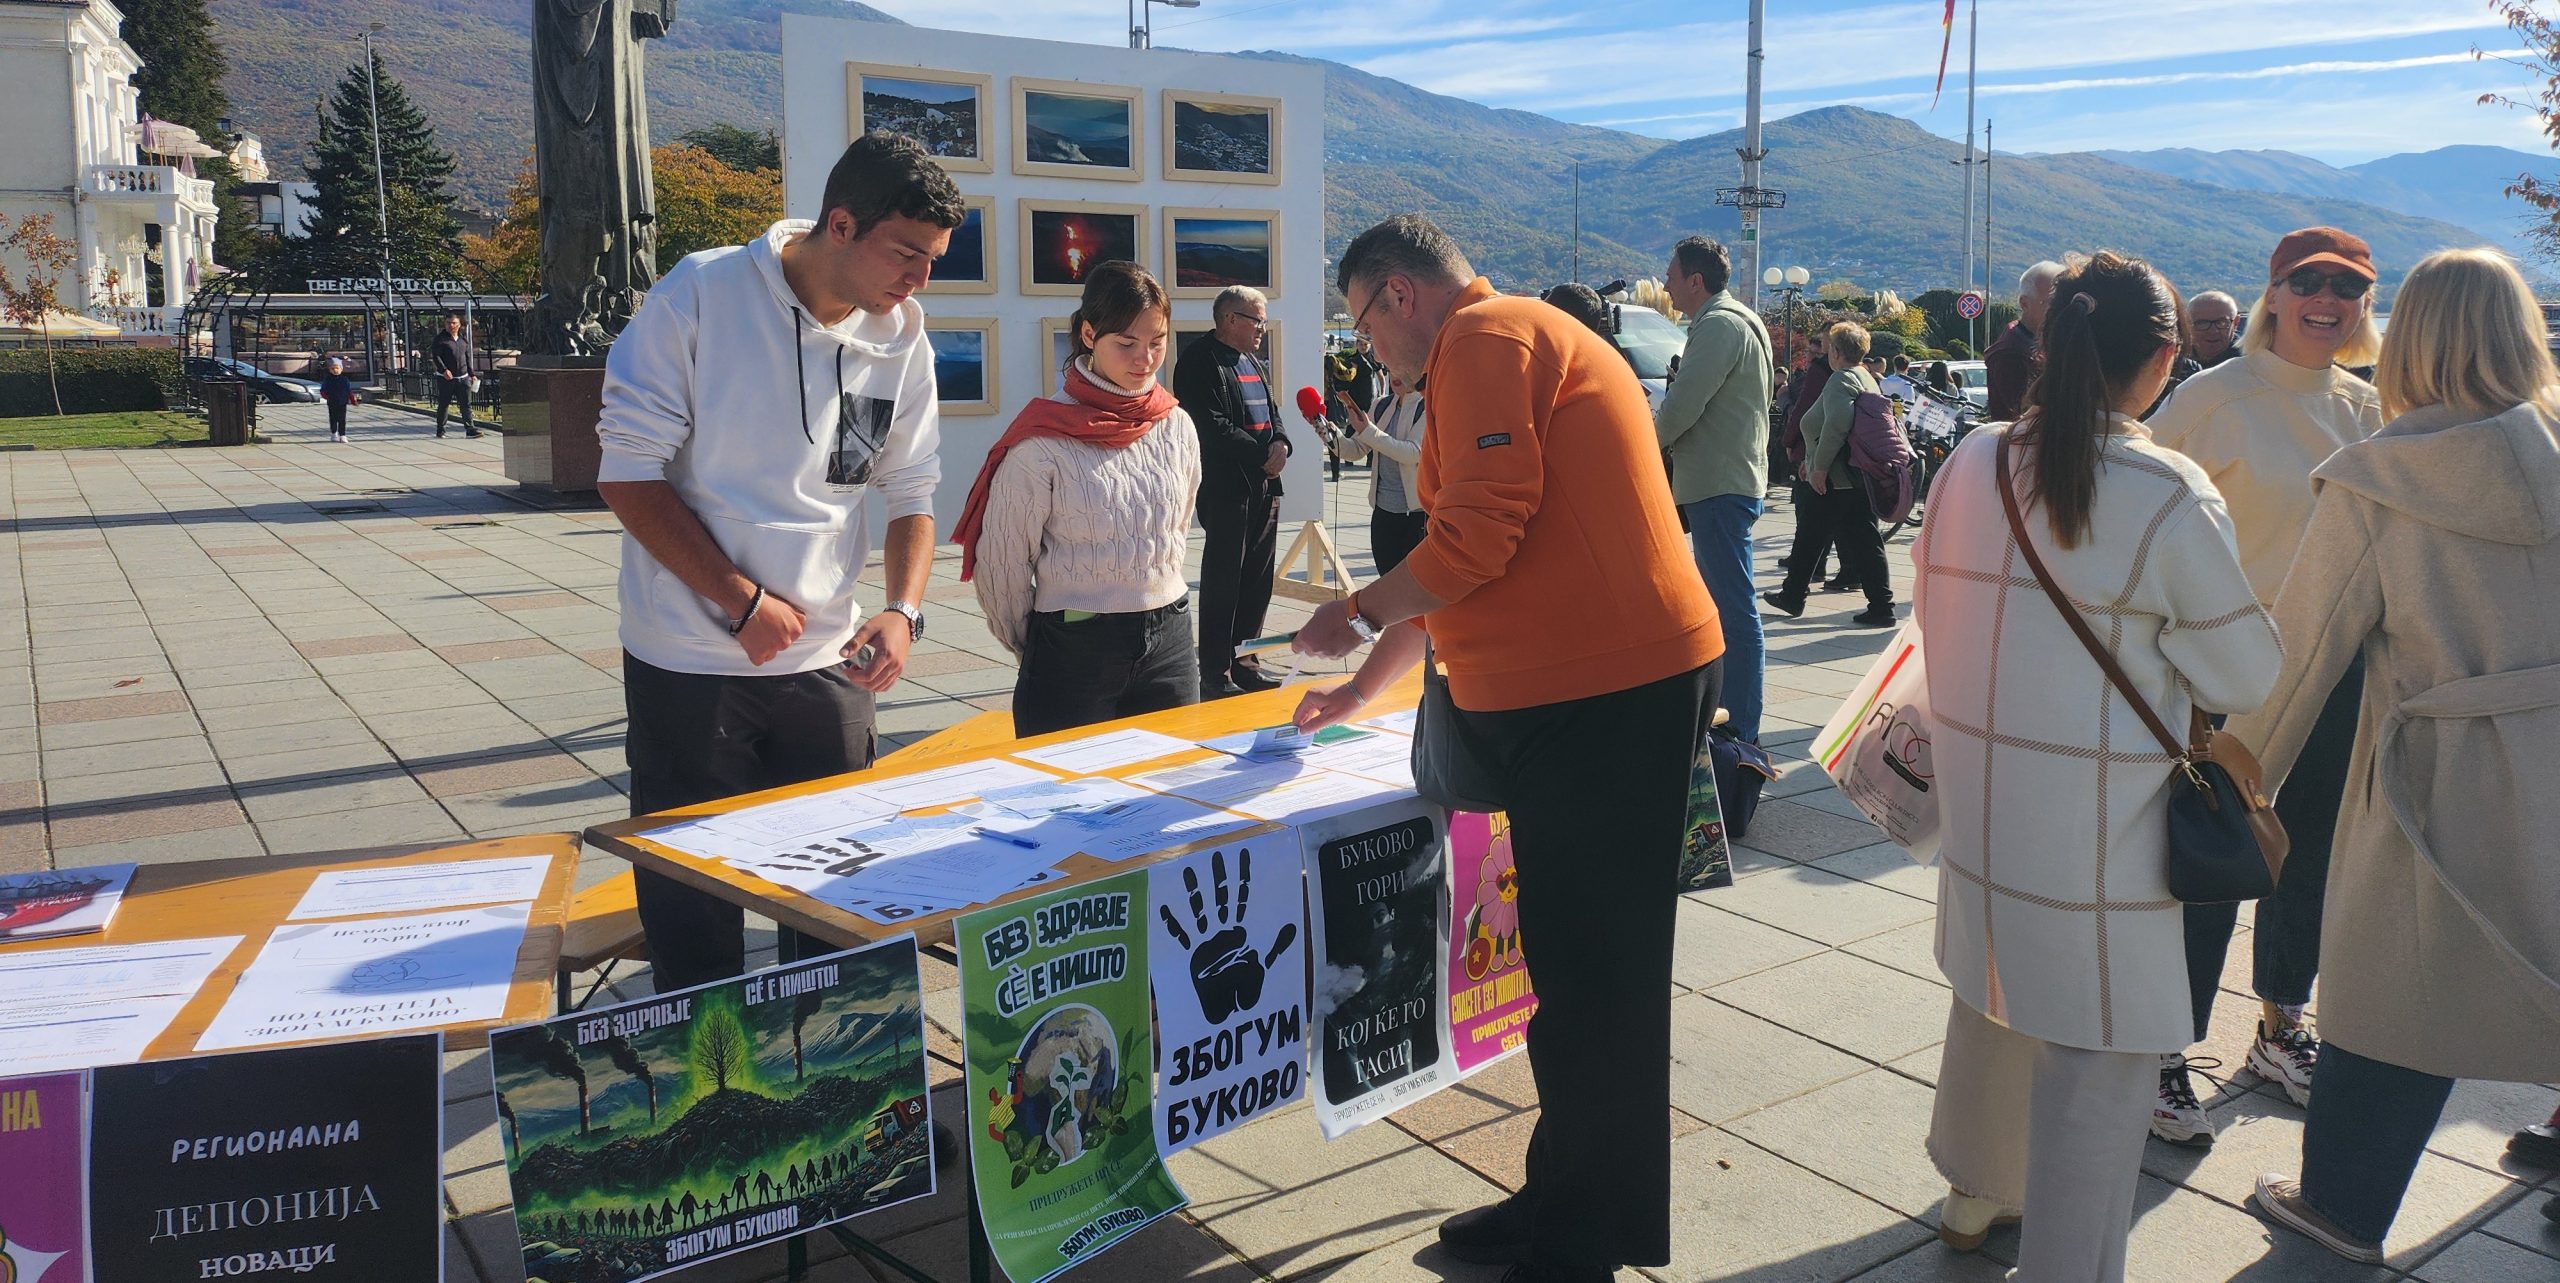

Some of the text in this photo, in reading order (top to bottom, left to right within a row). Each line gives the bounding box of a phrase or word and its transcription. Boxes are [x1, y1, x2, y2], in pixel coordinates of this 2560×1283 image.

[306, 279, 337, 291] THE
[1338, 827, 1415, 870] БУКОВО
[1356, 869, 1406, 906] ГОРИ
[984, 894, 1129, 968] БЕЗ ЗДРАВЈЕ
[1031, 965, 1047, 1001] Е
[1049, 945, 1126, 994] НИШТО
[577, 1017, 609, 1046] БЕЗ
[613, 998, 692, 1037] ЗДРАВЈЕ
[767, 978, 777, 1001] Е
[779, 964, 839, 998] НИШТО!
[1336, 997, 1426, 1051] КОЈ ЌЕ ГО
[1451, 984, 1482, 1025] СПАСЕТЕ
[1471, 1006, 1531, 1044] ПРИКЛУЧЕТЕ
[1168, 1003, 1301, 1087] ЗБОГУМ
[1354, 1038, 1413, 1085] ГАСИ?
[1500, 1030, 1525, 1052] СЕГА
[1167, 1060, 1299, 1147] БУКОВО
[171, 1119, 360, 1164] РЕГИОНАЛНА
[149, 1184, 381, 1244] ДЕПОНИЈА
[1029, 1173, 1097, 1212] ПРИДРУЖЕТЕ
[665, 1205, 798, 1263] ЗБОГУМ БУКОВО
[1059, 1206, 1145, 1259] ЗБОГУМ БУКОВО
[199, 1243, 336, 1279] НОВАЦИ
